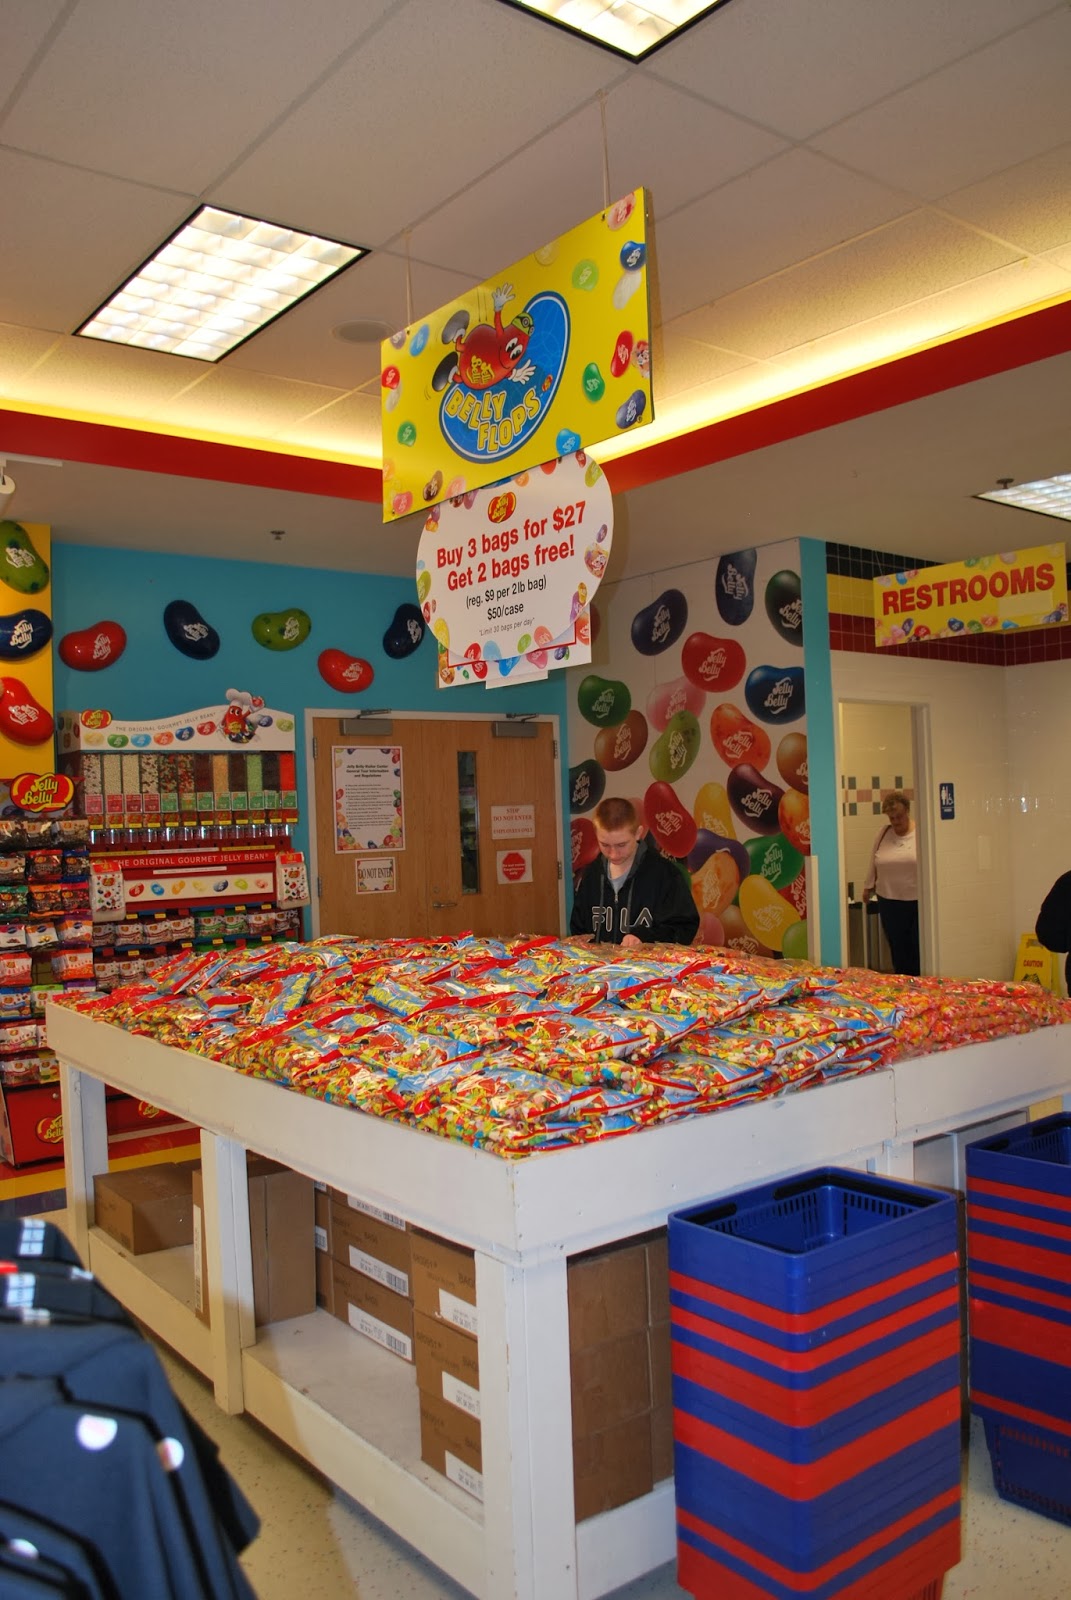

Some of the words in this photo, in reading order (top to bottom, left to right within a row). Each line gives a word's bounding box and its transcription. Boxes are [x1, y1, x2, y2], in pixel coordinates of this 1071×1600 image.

[446, 388, 506, 429] BELLY
[478, 390, 541, 453] FLOPS
[437, 547, 463, 568] Buy
[467, 538, 476, 558] 3
[482, 528, 518, 555] bags
[524, 518, 548, 540] for
[553, 500, 586, 533] $27
[447, 569, 473, 591] Get
[478, 562, 486, 582] 2
[492, 553, 529, 581] bags
[535, 534, 575, 566] free!
[466, 592, 483, 609] (reg.
[485, 589, 495, 603] $9
[496, 586, 510, 602] per
[512, 582, 525, 596] 2lb
[527, 574, 547, 590] bag)
[883, 562, 1056, 617] RESTROOMS
[487, 602, 524, 621] $50/case
[14, 621, 33, 637] Jelly
[501, 623, 513, 632] bags
[513, 620, 523, 630] per
[10, 632, 33, 647] Belly
[698, 661, 721, 677] Belly
[707, 651, 727, 669] Jelly
[773, 680, 793, 698] Jelly
[592, 700, 610, 715] Belly
[599, 691, 615, 706] Jelly
[764, 693, 789, 708] Belly
[157, 720, 183, 730] GOURMET
[184, 715, 199, 725] JELLY
[723, 736, 745, 758] Belly
[734, 731, 753, 751] Jelly
[31, 778, 58, 794] Jelly
[21, 791, 52, 806] Belly
[741, 794, 764, 818] Belly
[752, 789, 773, 811] Jelly
[133, 857, 175, 866] ORIGINAL
[178, 855, 218, 864] GOURMET
[220, 854, 241, 862] JELLY
[764, 847, 783, 864] Jelly
[592, 906, 653, 933] FILA
[1023, 959, 1043, 968] CAUTION
